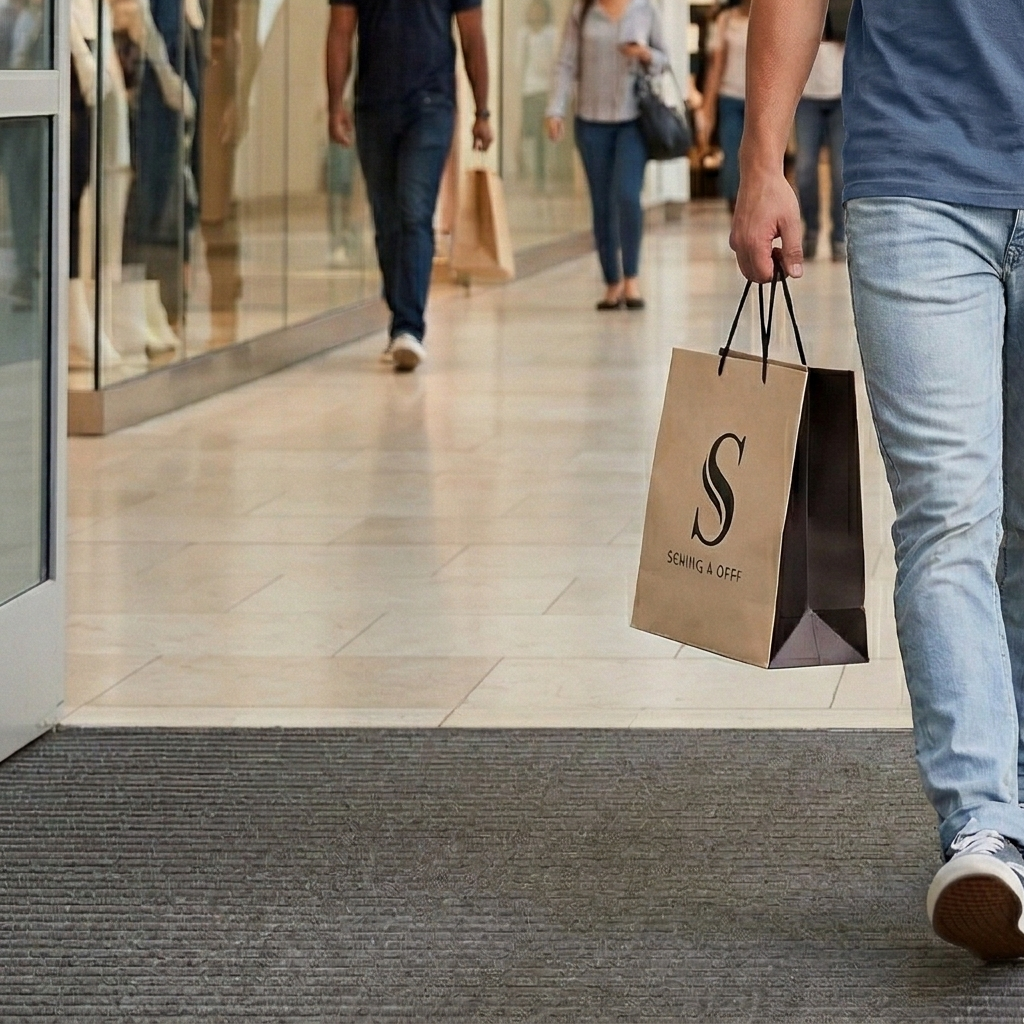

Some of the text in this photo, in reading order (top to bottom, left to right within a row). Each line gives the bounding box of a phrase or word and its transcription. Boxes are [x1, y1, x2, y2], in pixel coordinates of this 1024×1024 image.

[691, 432, 747, 547] S
[706, 561, 713, 575] A
[716, 564, 743, 583] OFFF
